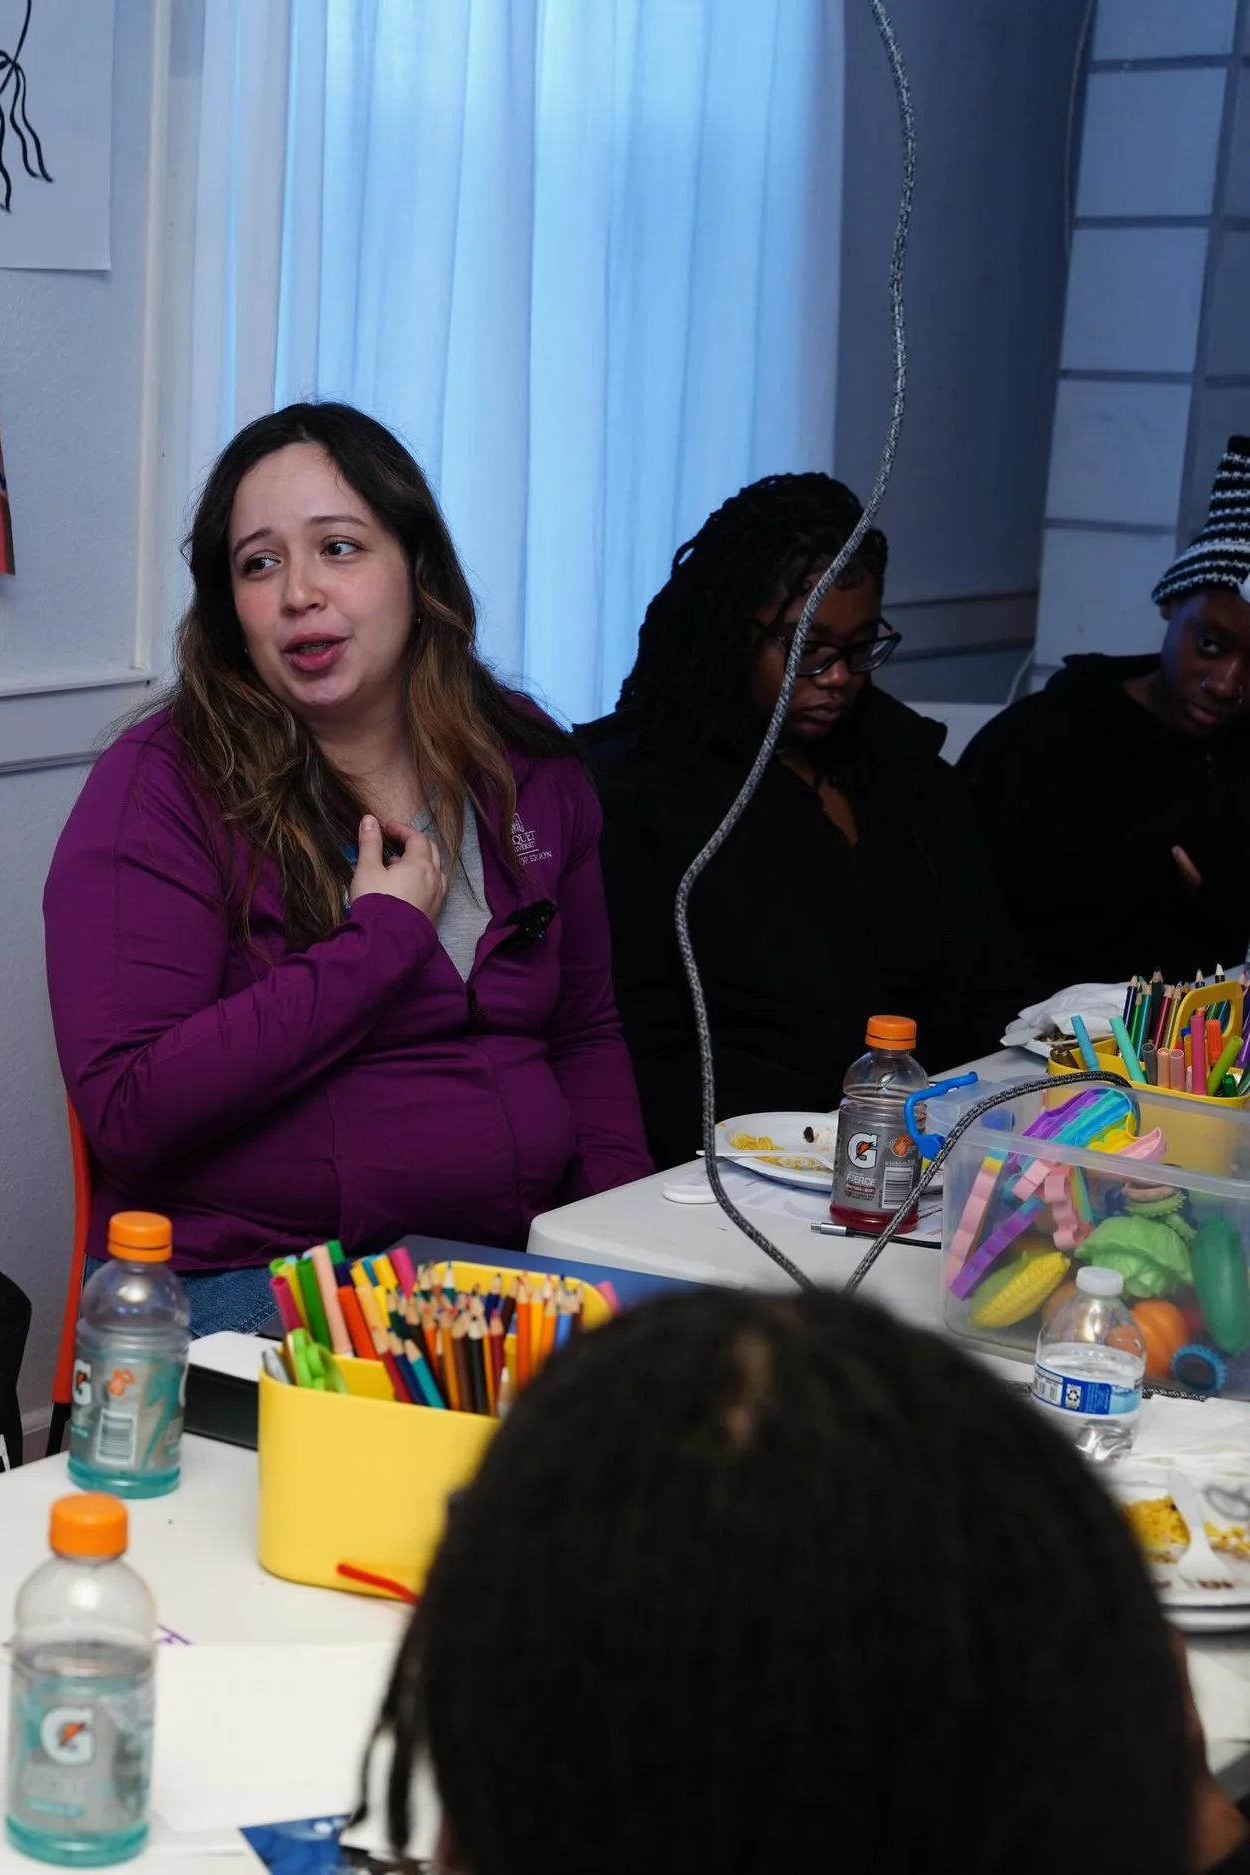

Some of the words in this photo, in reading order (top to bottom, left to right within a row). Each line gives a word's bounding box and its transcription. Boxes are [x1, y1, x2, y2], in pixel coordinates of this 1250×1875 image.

[847, 1132, 878, 1169] G
[846, 1173, 877, 1187] FIERCE
[40, 1706, 93, 1766] G
